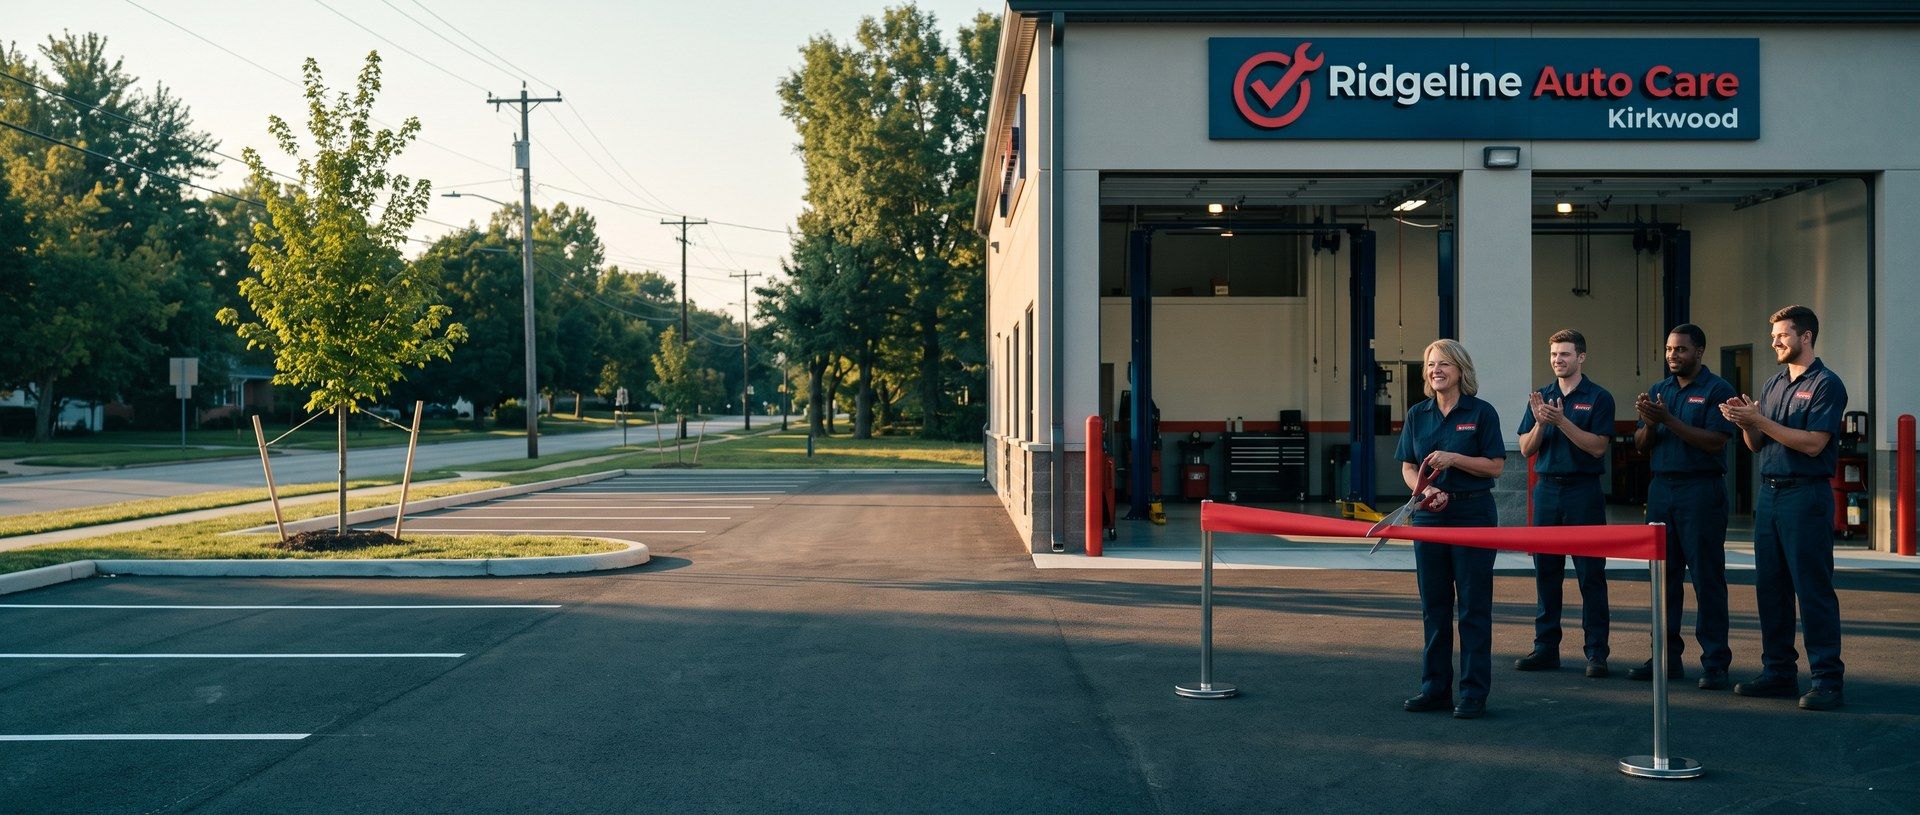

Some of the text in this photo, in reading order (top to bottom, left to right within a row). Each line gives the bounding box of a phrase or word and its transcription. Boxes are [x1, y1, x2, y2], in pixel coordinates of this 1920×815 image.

[1329, 62, 1740, 105] Ridgeline Auto Care
[1608, 106, 1739, 129] Kirkwood
